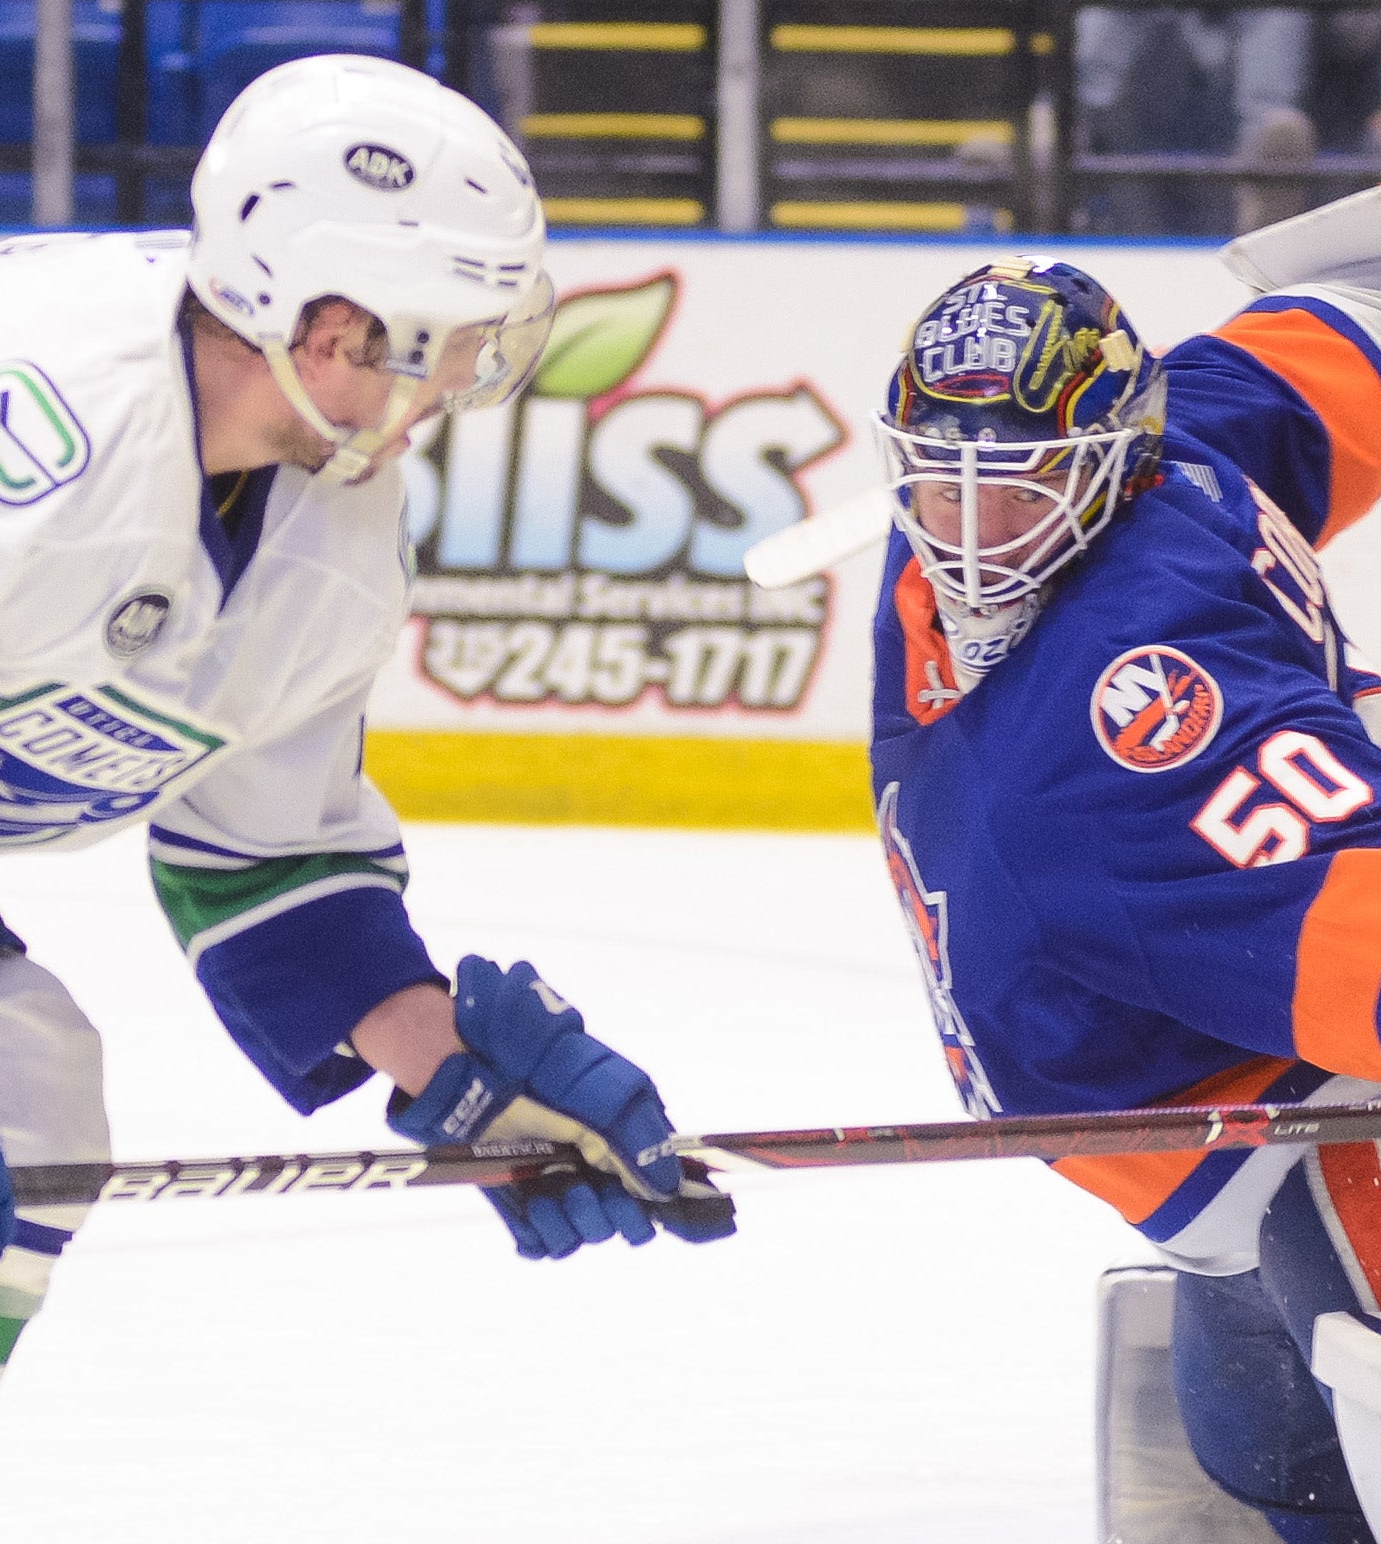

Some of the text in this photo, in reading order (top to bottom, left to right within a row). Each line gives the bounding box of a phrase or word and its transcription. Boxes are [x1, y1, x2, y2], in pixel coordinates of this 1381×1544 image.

[347, 147, 410, 188] ADK
[915, 300, 1032, 347] BLUES
[921, 335, 1018, 383] CLUB
[1188, 730, 1375, 869] 50
[97, 1158, 429, 1201] BAUER
